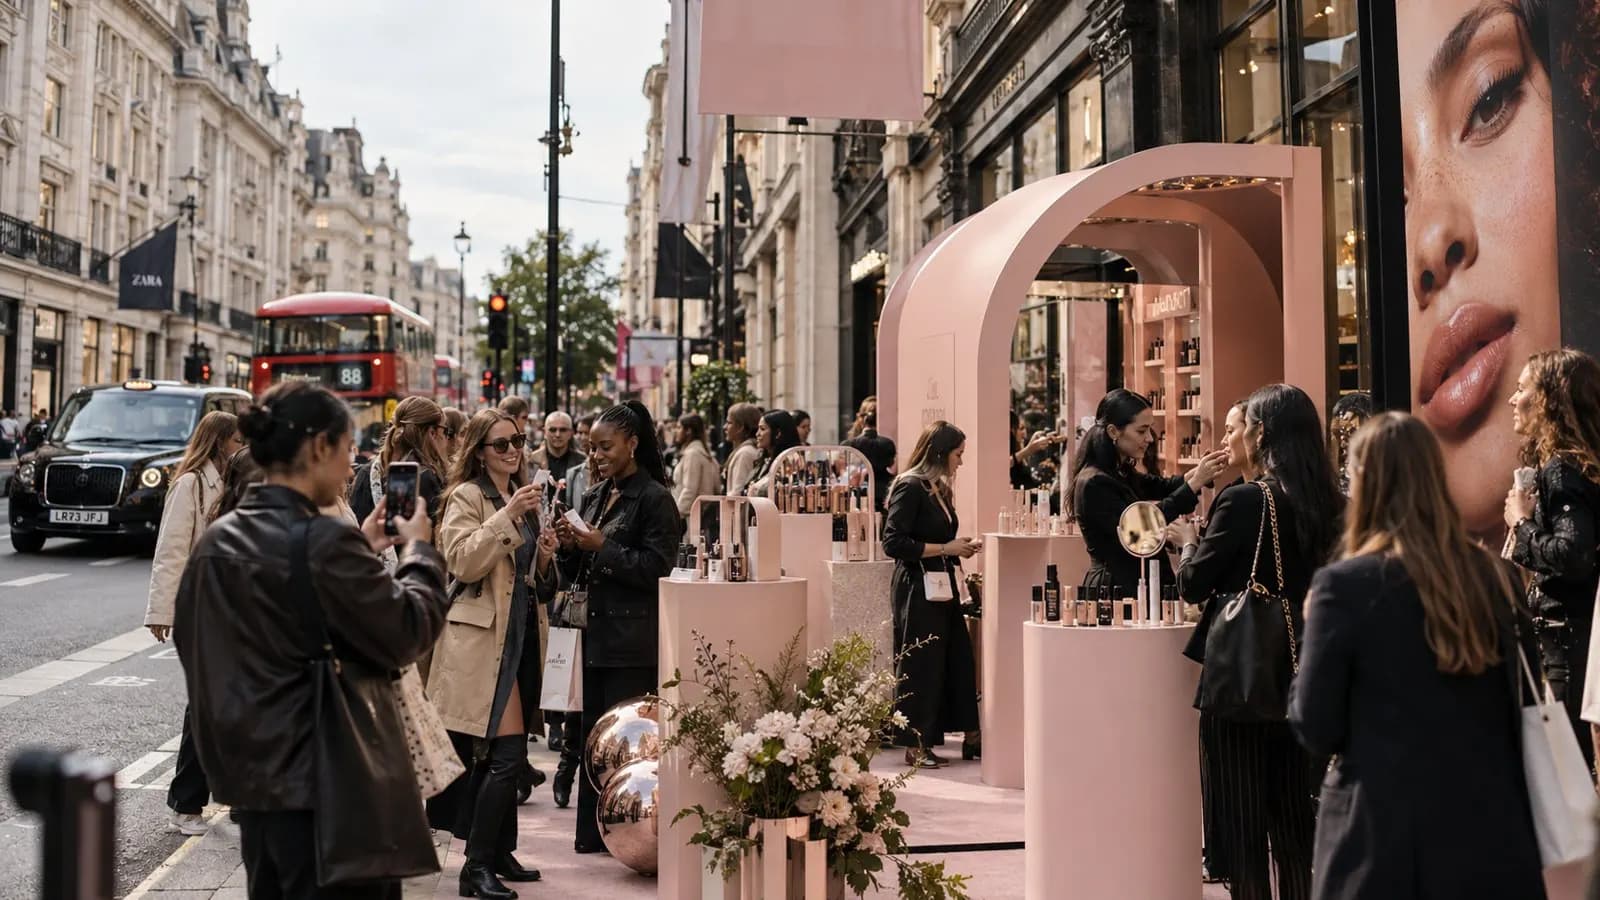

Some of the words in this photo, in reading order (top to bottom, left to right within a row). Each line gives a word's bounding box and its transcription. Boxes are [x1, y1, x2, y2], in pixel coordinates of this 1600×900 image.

[132, 274, 162, 287] ZARA
[341, 368, 362, 385] 88
[55, 511, 81, 522] LR73
[84, 512, 103, 523] JFJ
